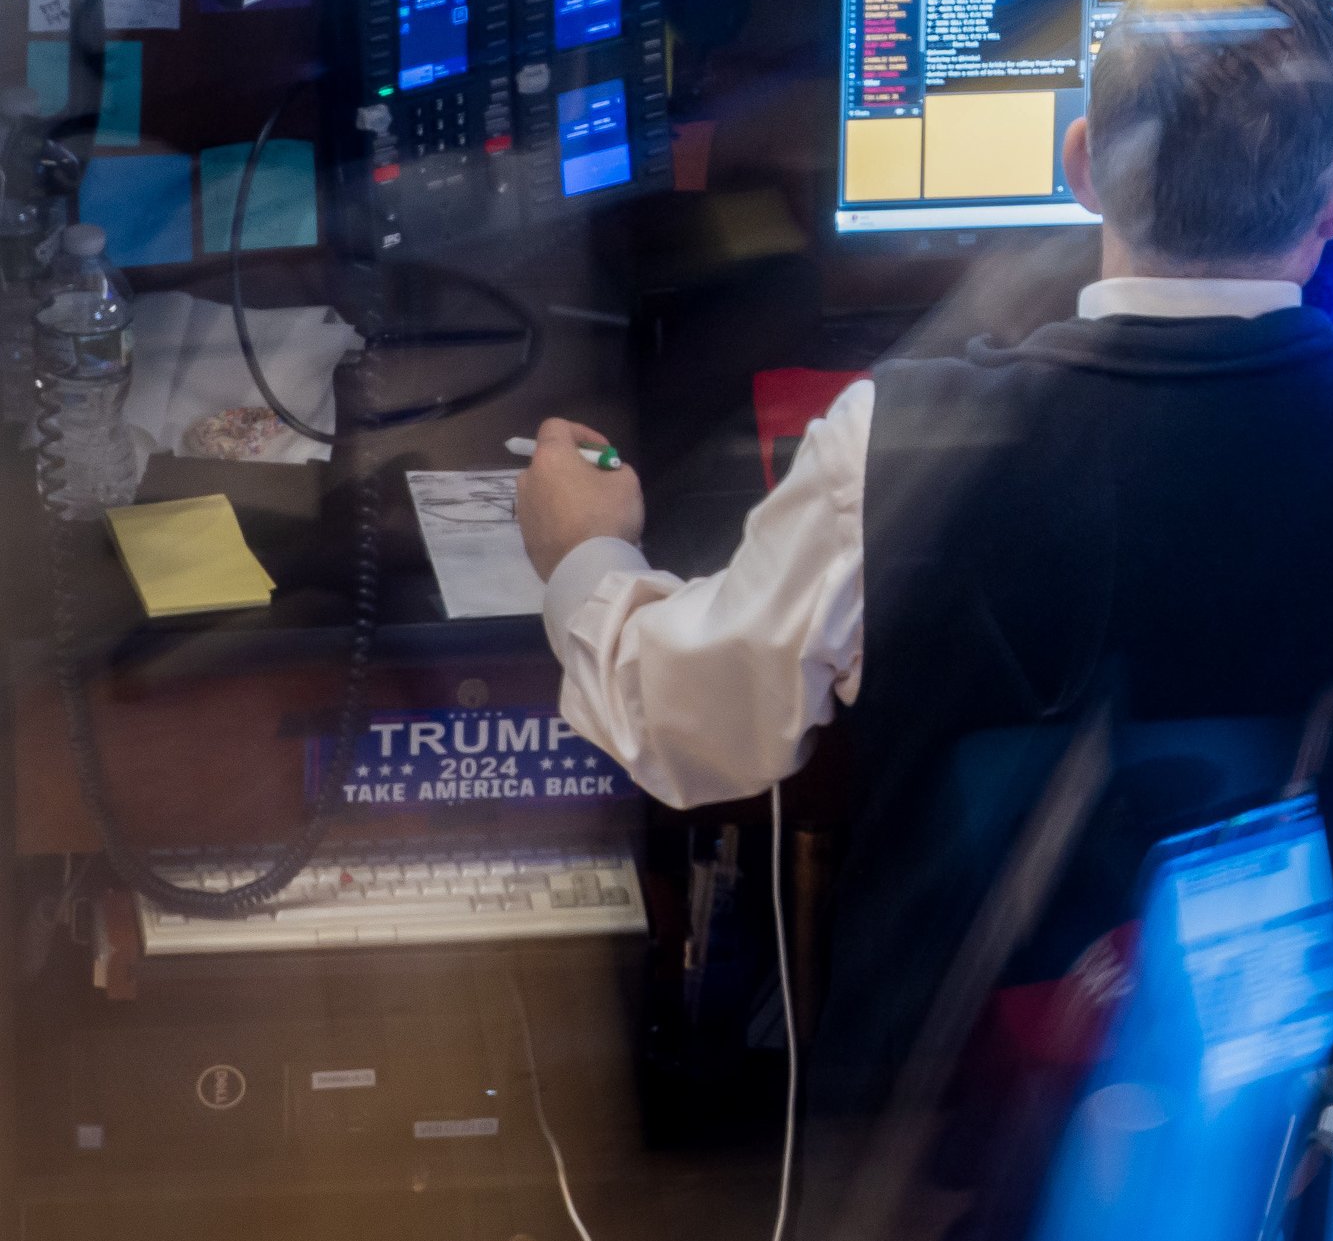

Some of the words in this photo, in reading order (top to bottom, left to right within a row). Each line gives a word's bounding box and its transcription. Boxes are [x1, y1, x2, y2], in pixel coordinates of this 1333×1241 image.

[369, 716, 578, 757] TRUMP
[439, 756, 519, 780] 2024
[343, 782, 407, 803] TAKE
[418, 777, 536, 801] AMERICA
[545, 775, 614, 796] BACK
